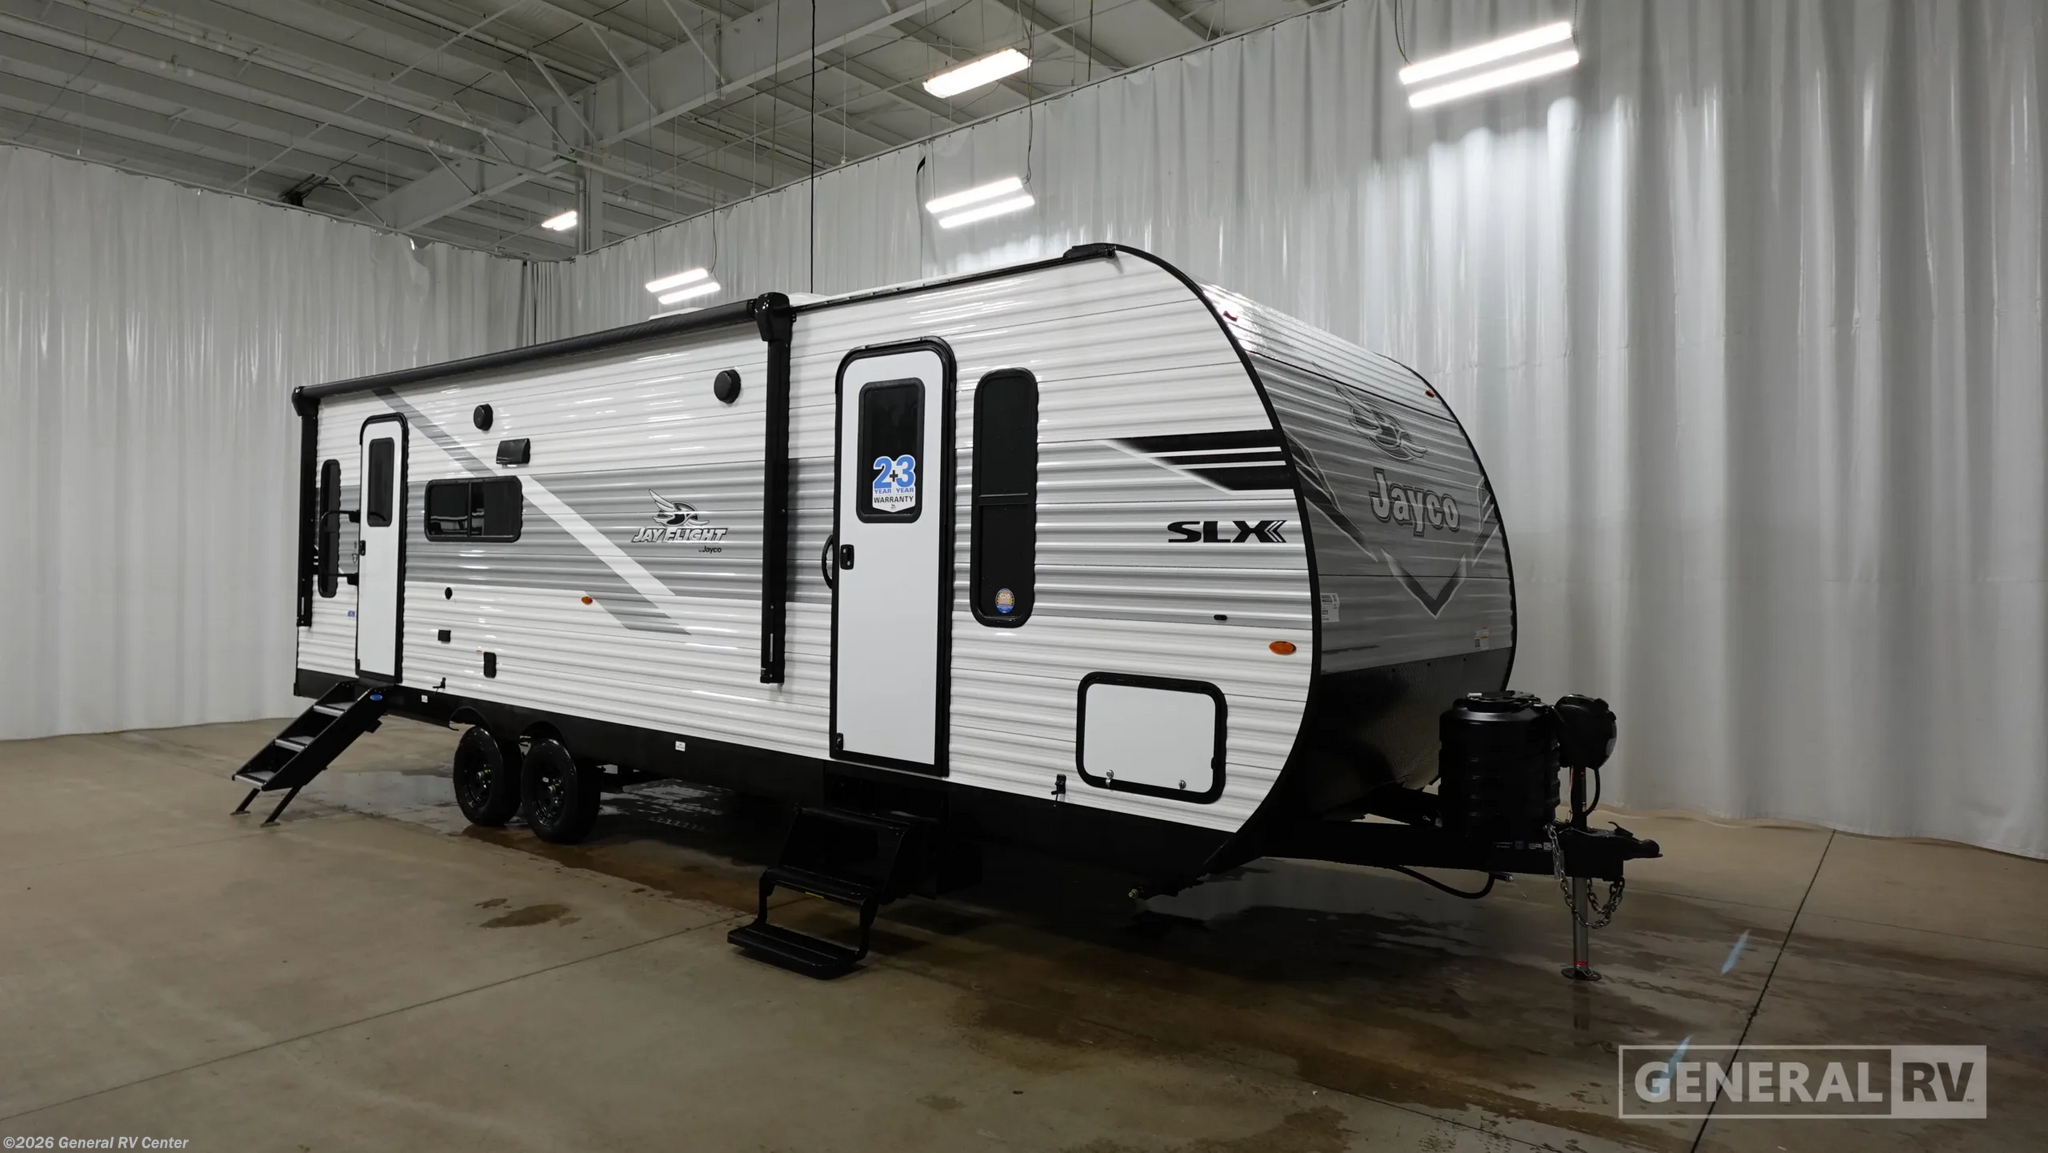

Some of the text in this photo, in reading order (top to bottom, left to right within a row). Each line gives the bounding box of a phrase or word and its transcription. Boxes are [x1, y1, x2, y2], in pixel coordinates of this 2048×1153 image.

[1369, 467, 1460, 538] Jayco
[631, 528, 729, 543] JAY FLIGHT
